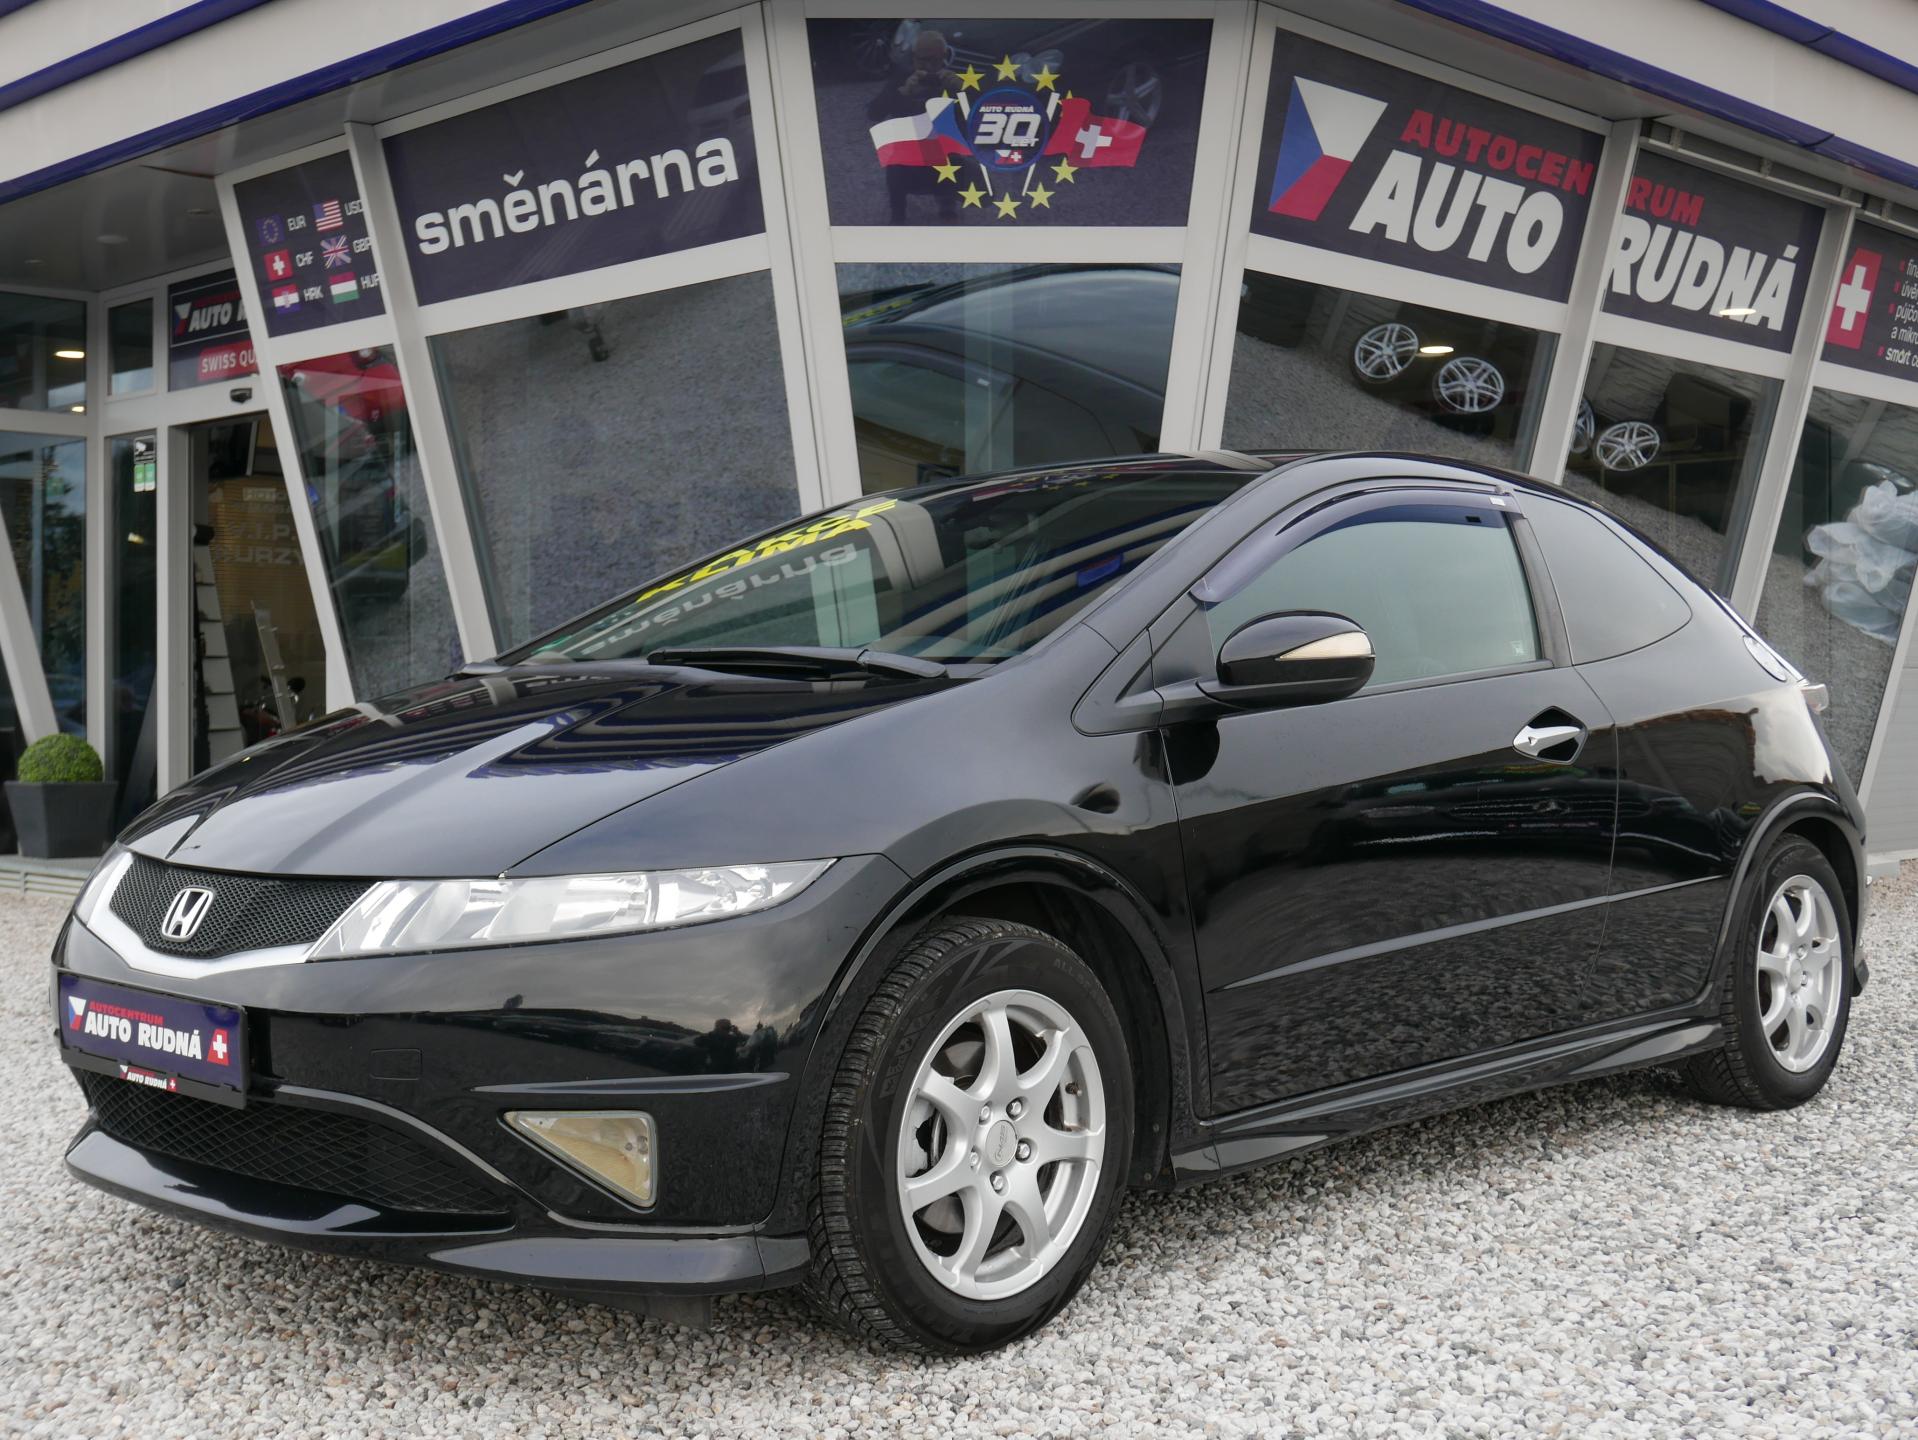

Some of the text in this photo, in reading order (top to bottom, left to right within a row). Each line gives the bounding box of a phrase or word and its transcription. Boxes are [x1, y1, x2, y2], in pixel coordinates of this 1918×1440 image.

[974, 113, 1041, 144] 30
[415, 137, 738, 255] směnárna
[287, 215, 306, 231] EUR
[1348, 149, 1799, 331] AUTO RUDNÁ
[295, 251, 314, 267] CHF
[188, 302, 232, 332] AUTO
[202, 352, 236, 373] SWISS
[89, 1001, 164, 1026] AUTOCENTRUM
[84, 1011, 202, 1060] AUTO RUDNÁ
[126, 1071, 144, 1084] AUTO
